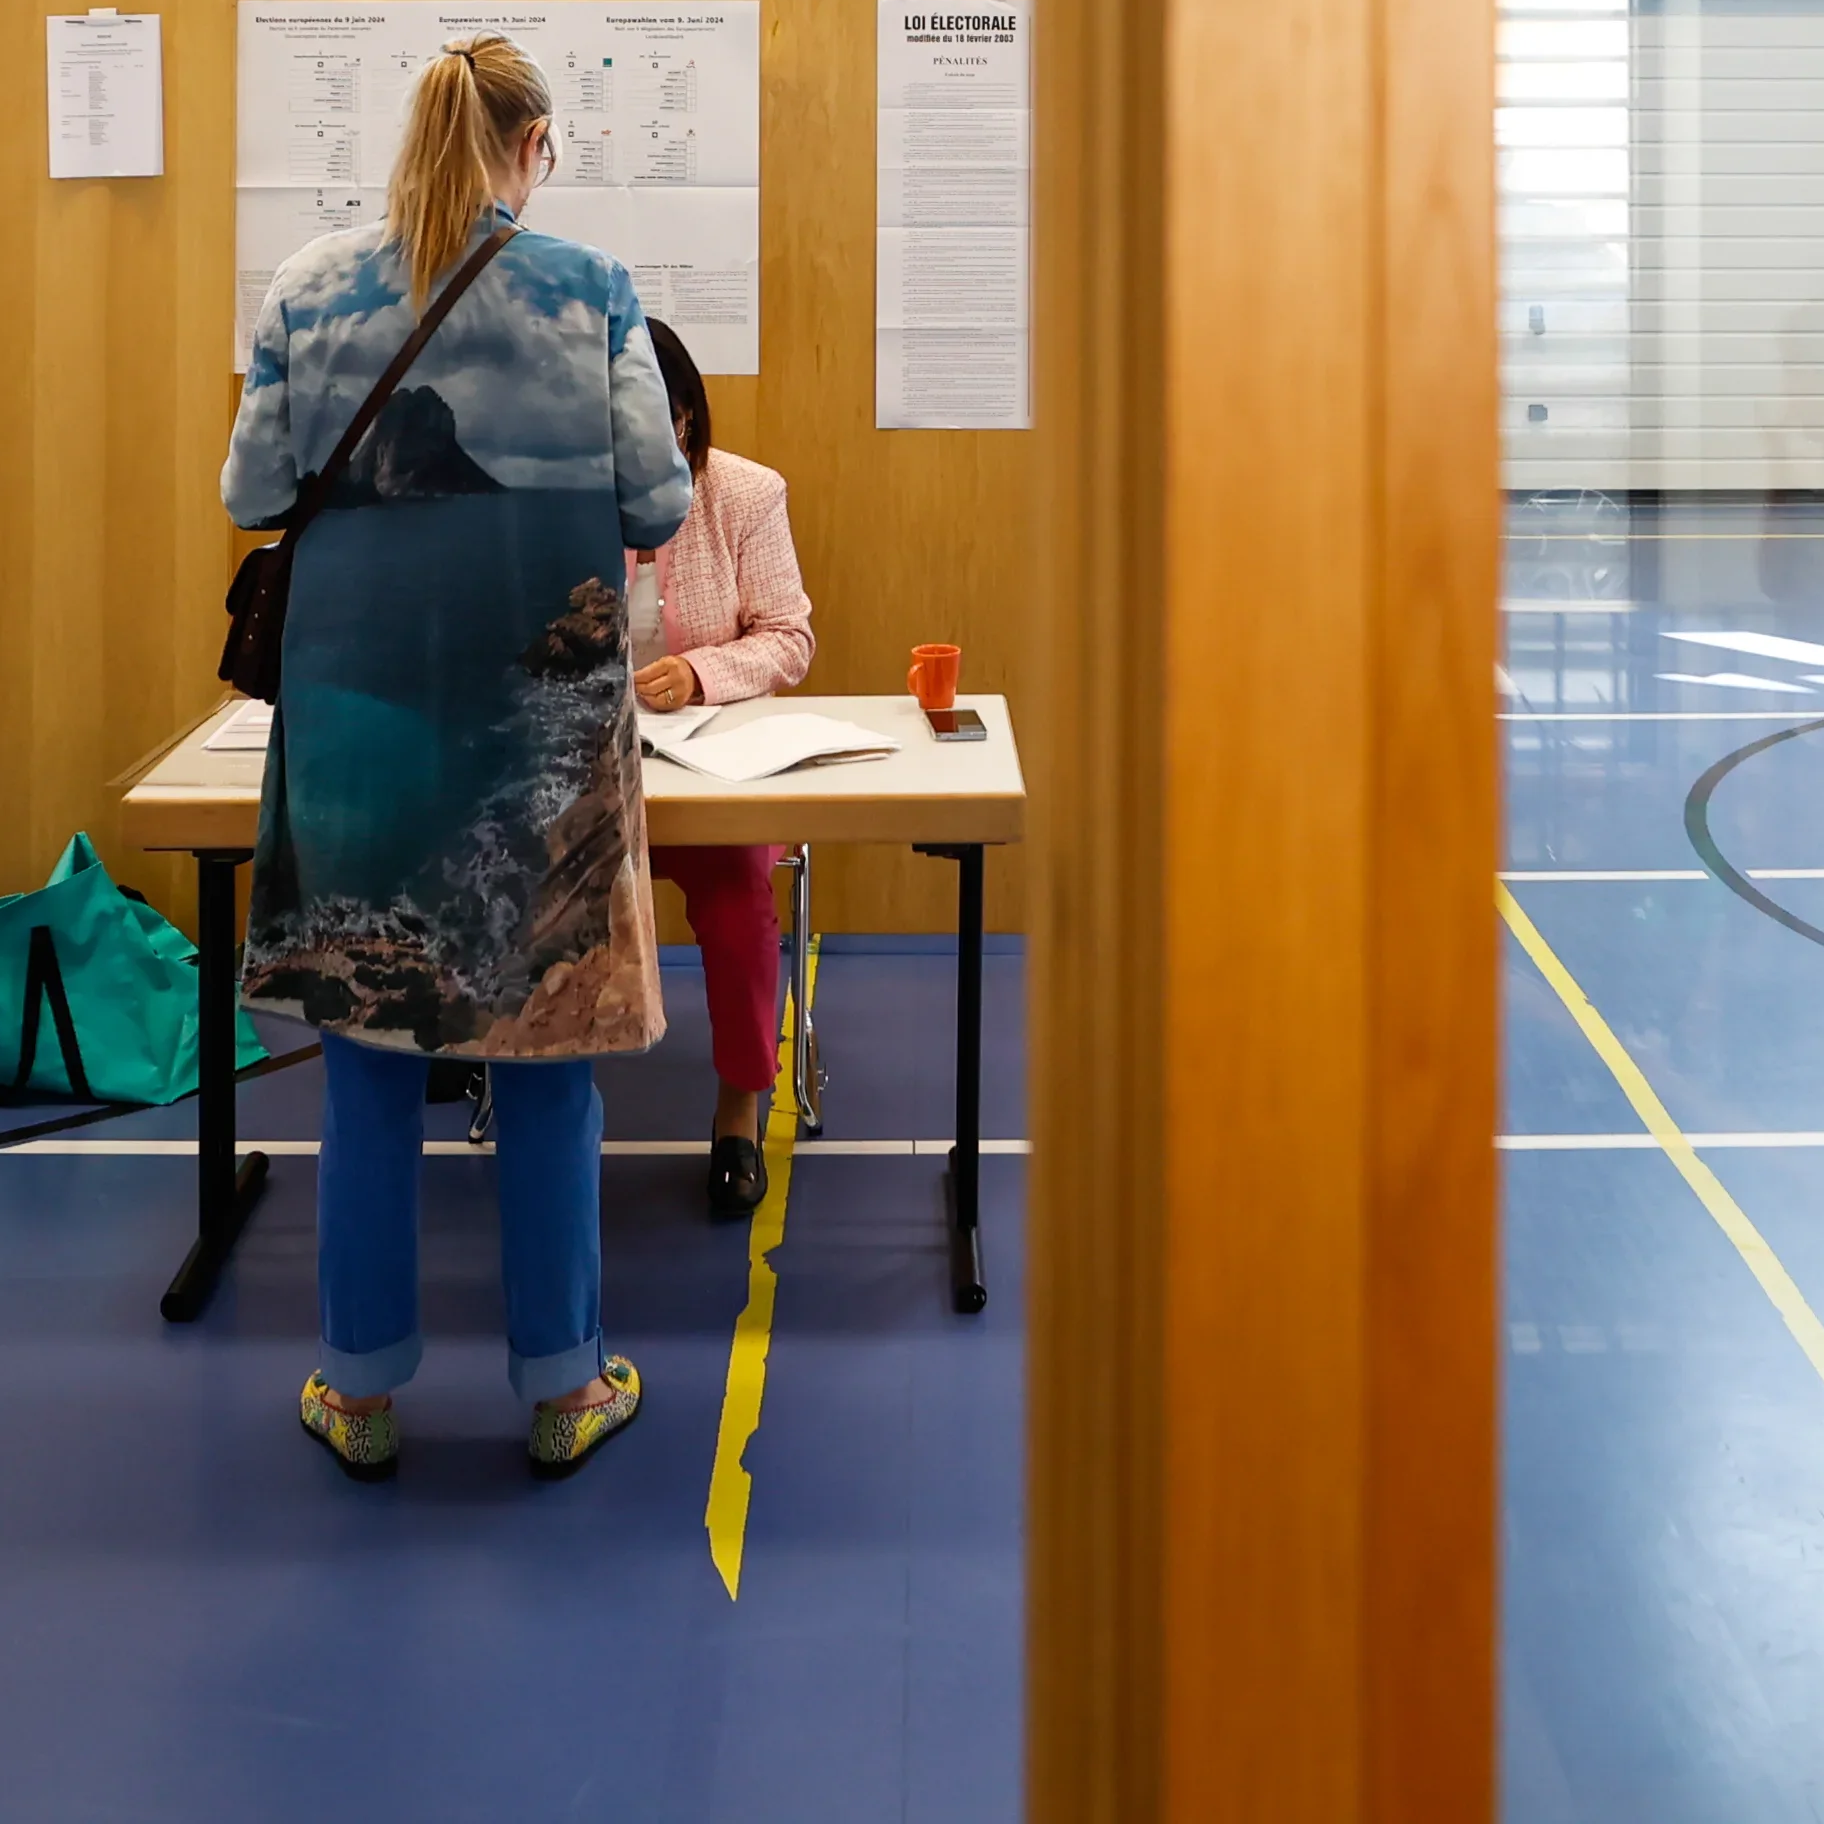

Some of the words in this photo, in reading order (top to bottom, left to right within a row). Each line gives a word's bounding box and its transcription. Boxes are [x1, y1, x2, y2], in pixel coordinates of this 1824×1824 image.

[334, 16, 343, 24] du
[344, 16, 350, 24] 9
[367, 16, 386, 24] 2024
[511, 16, 527, 24] Juni
[528, 16, 546, 24] 2024
[606, 16, 658, 25] Europawahlen
[677, 16, 685, 24] 9.
[687, 16, 703, 24] Juni
[705, 16, 724, 24] 2024
[904, 15, 925, 31] LOI
[931, 12, 1016, 31] ÉLECTORALE
[907, 34, 940, 43] modifiée
[943, 34, 952, 43] du
[956, 34, 964, 43] 18
[994, 34, 1014, 43] 2003
[933, 55, 988, 65] PÉNALITÉS
